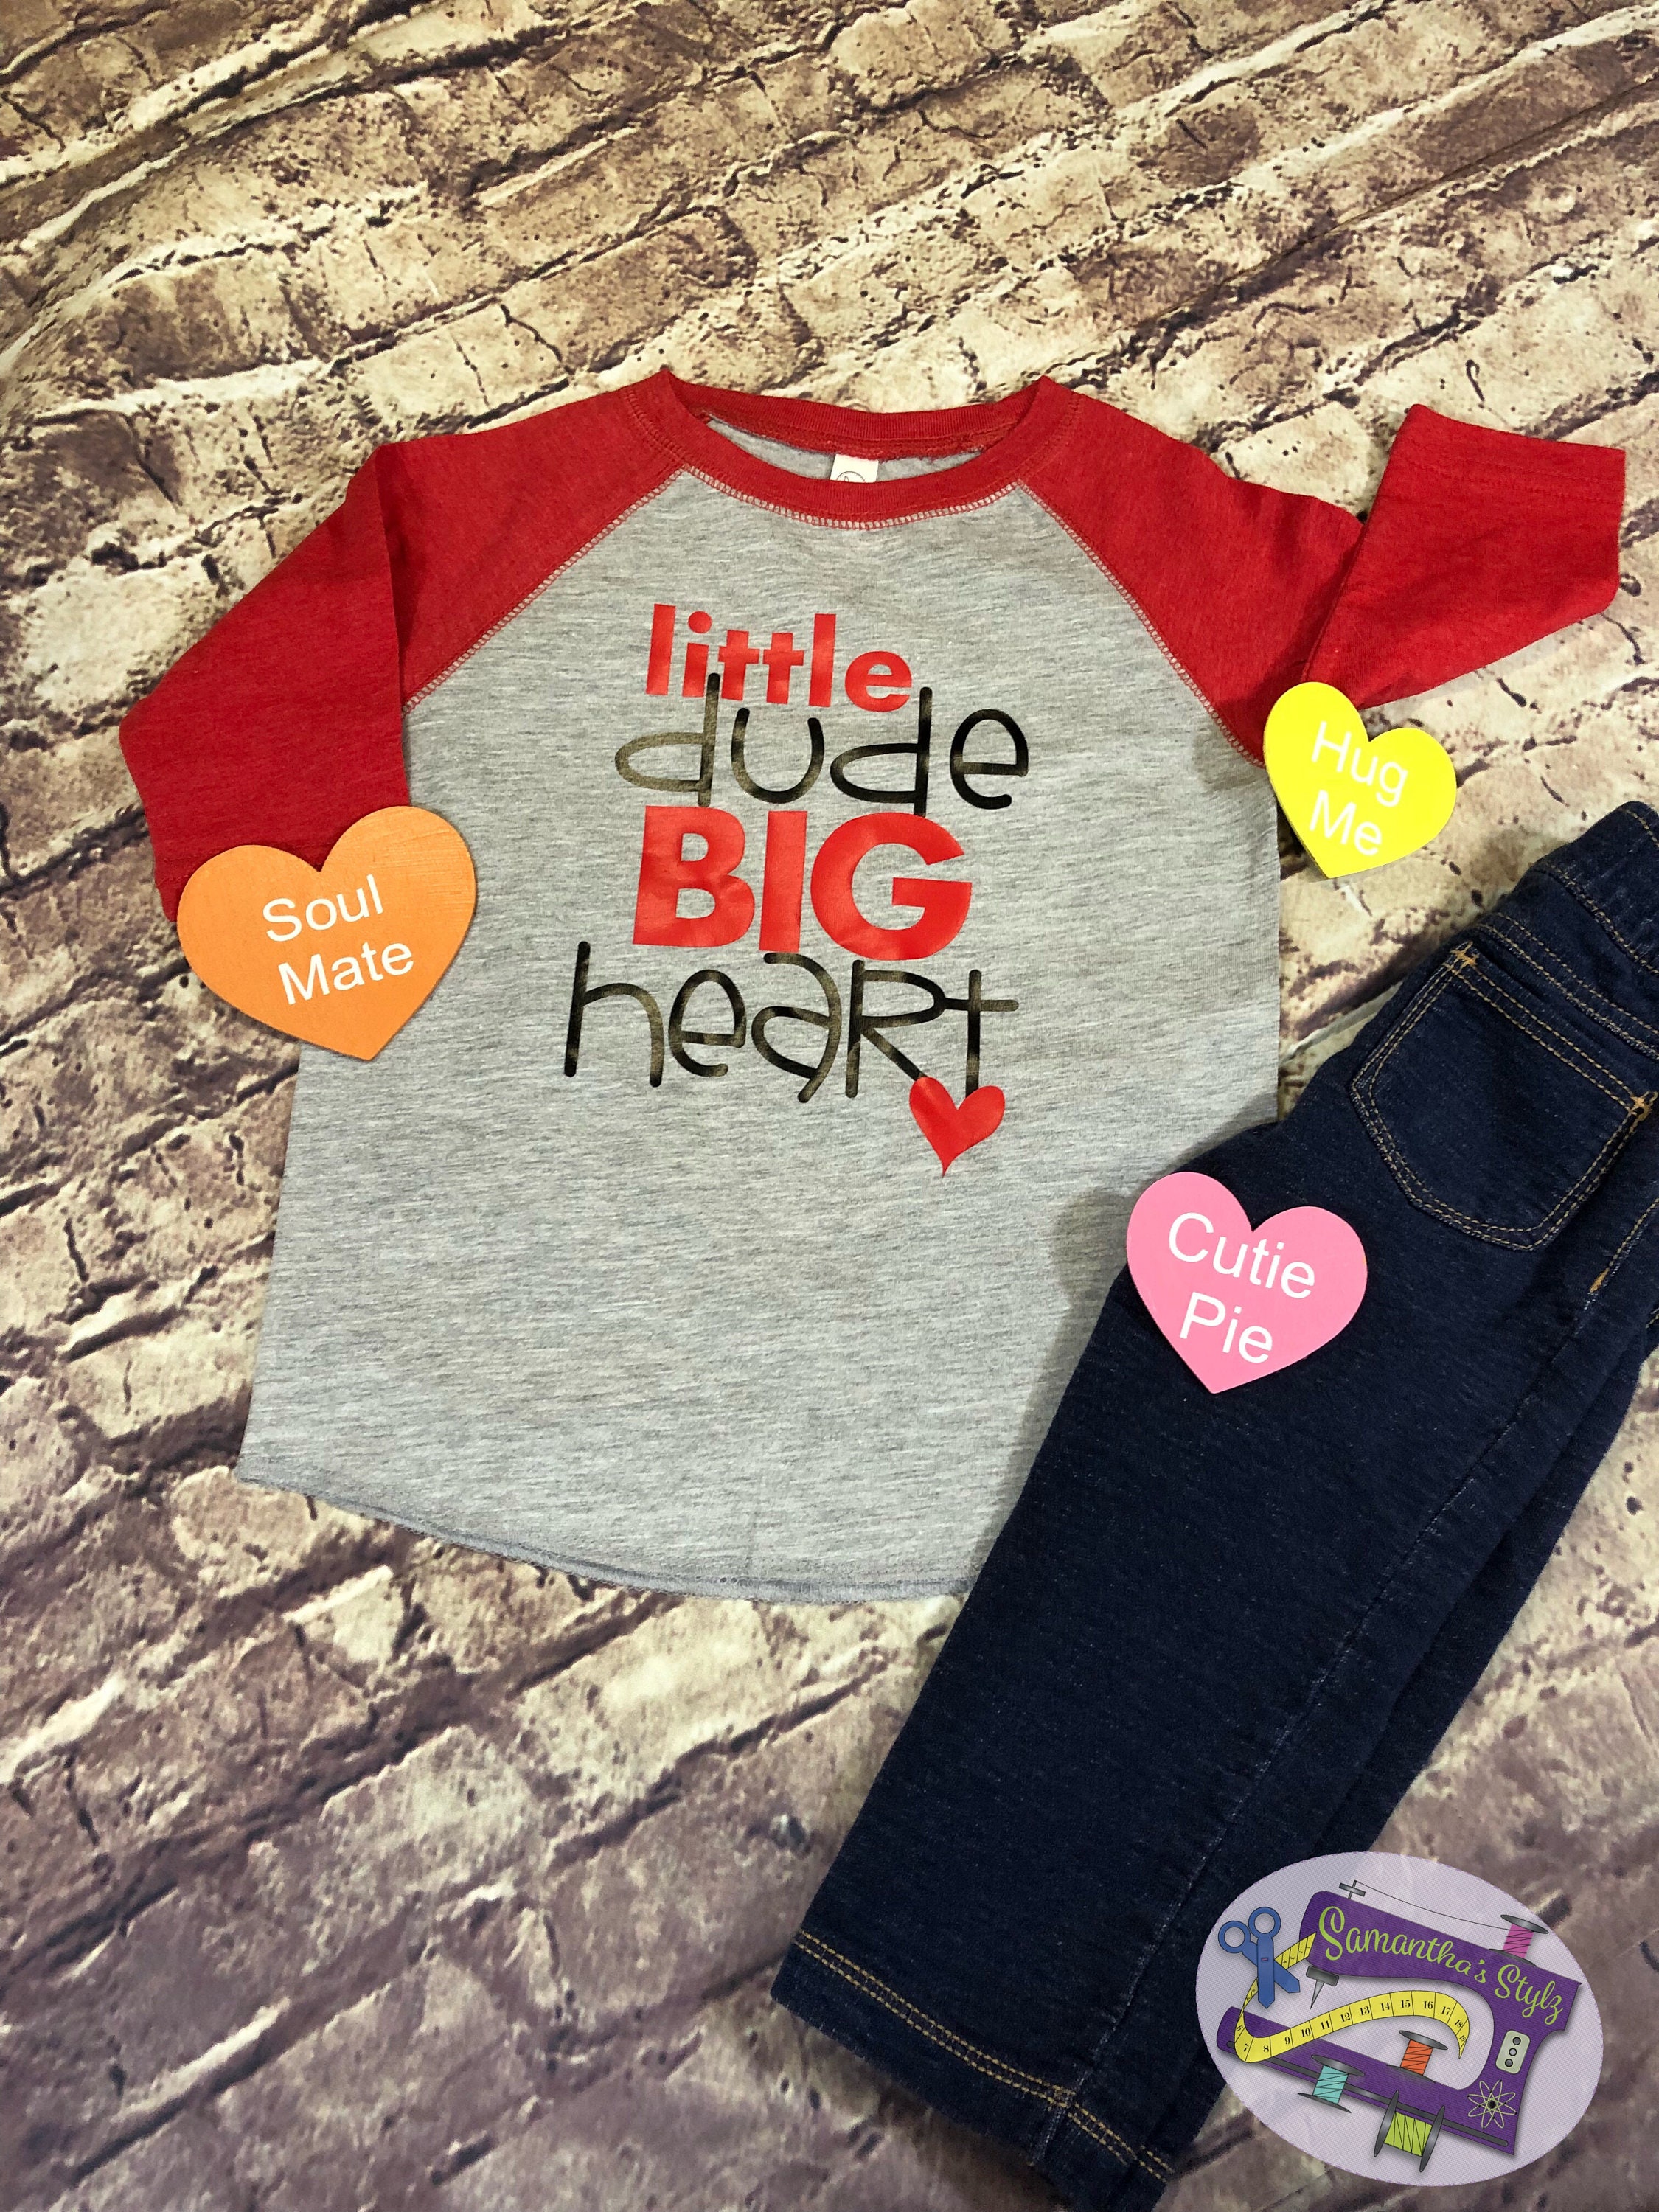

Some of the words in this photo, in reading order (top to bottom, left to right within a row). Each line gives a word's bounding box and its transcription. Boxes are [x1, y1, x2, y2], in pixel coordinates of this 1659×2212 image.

[646, 603, 912, 712] little
[615, 672, 1029, 817] dude
[1311, 720, 1408, 807] Hug
[1309, 790, 1382, 856] Me
[262, 874, 384, 942] Soul
[633, 805, 973, 961] BIG
[277, 942, 414, 1006] Mate
[1168, 1212, 1315, 1299] Cutie
[1179, 1291, 1273, 1363] Pie
